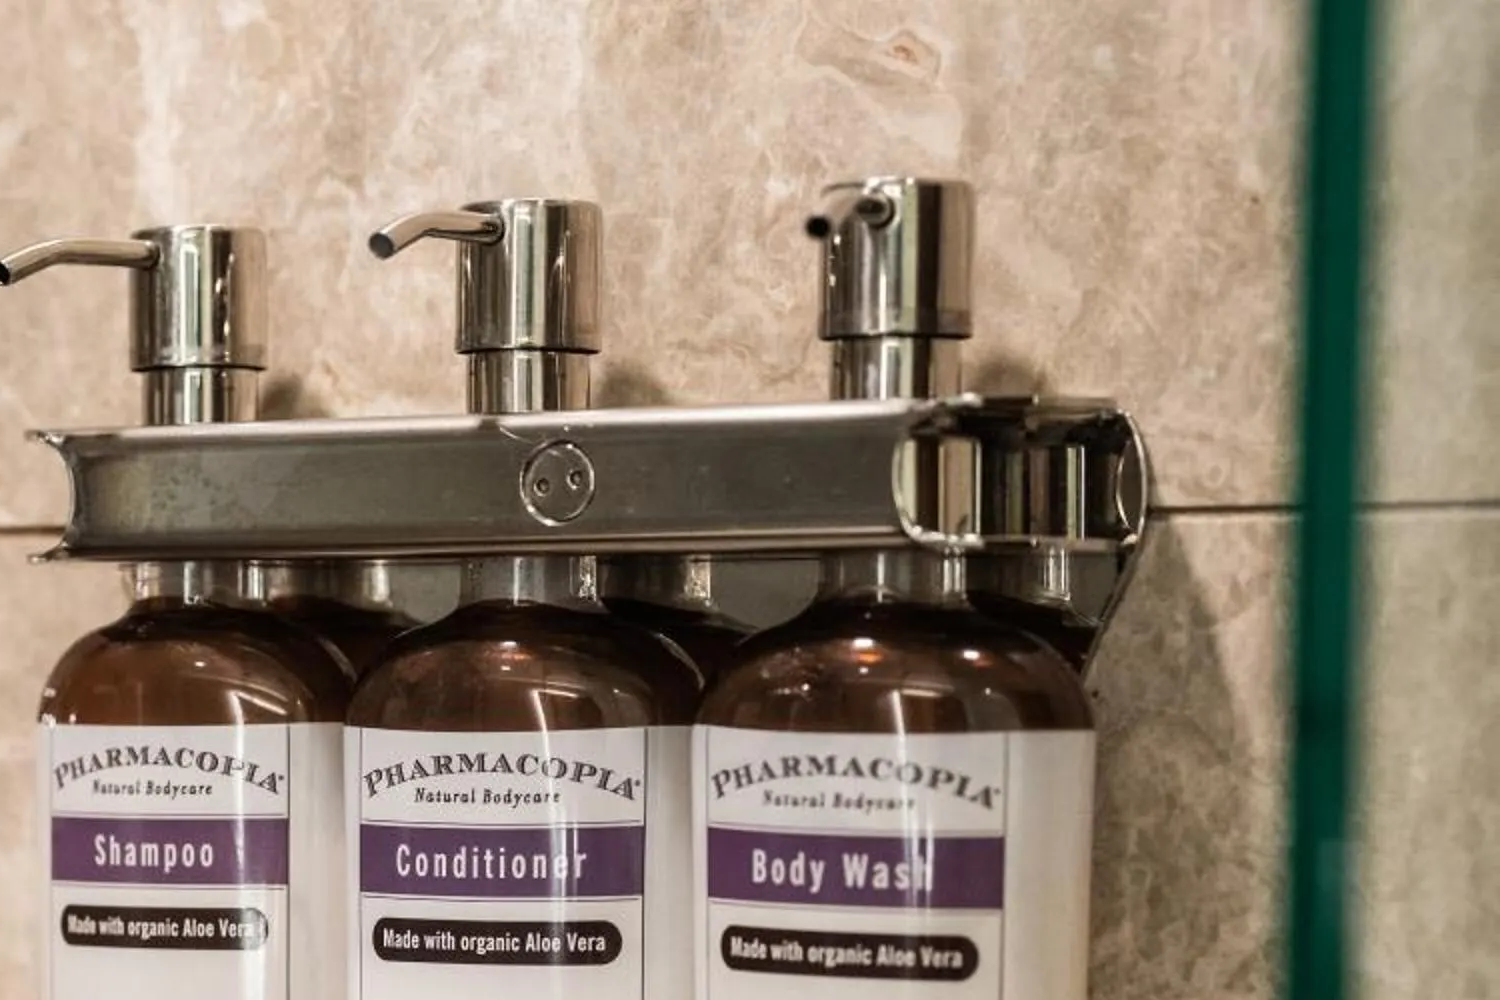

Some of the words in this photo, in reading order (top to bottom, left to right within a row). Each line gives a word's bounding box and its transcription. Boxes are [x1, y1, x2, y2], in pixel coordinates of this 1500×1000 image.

[54, 745, 280, 795] PHARMACOPIA
[363, 752, 637, 800] PHARMACOPIA
[710, 755, 995, 810] PHARMACOPIA
[93, 779, 141, 796] Natural
[146, 780, 213, 800] Bodycare
[414, 787, 476, 804] Natural
[482, 787, 561, 808] Bodycare
[94, 833, 214, 873] Shampoo
[396, 843, 588, 880] Conditioner
[752, 848, 826, 894] Body
[842, 852, 934, 892] Wash
[67, 913, 96, 936] Made
[99, 914, 125, 937] with
[128, 917, 178, 941] organic
[182, 918, 215, 938] Aloe
[219, 919, 255, 938] Vera
[382, 928, 420, 949] Made
[424, 930, 456, 950] with
[460, 932, 520, 955] organic
[525, 933, 562, 952] Aloe
[566, 933, 607, 952] Vera
[730, 936, 768, 960] Made
[770, 939, 805, 962] with
[807, 943, 874, 968] organic
[876, 945, 915, 968] Aloe
[920, 945, 964, 969] Vera
